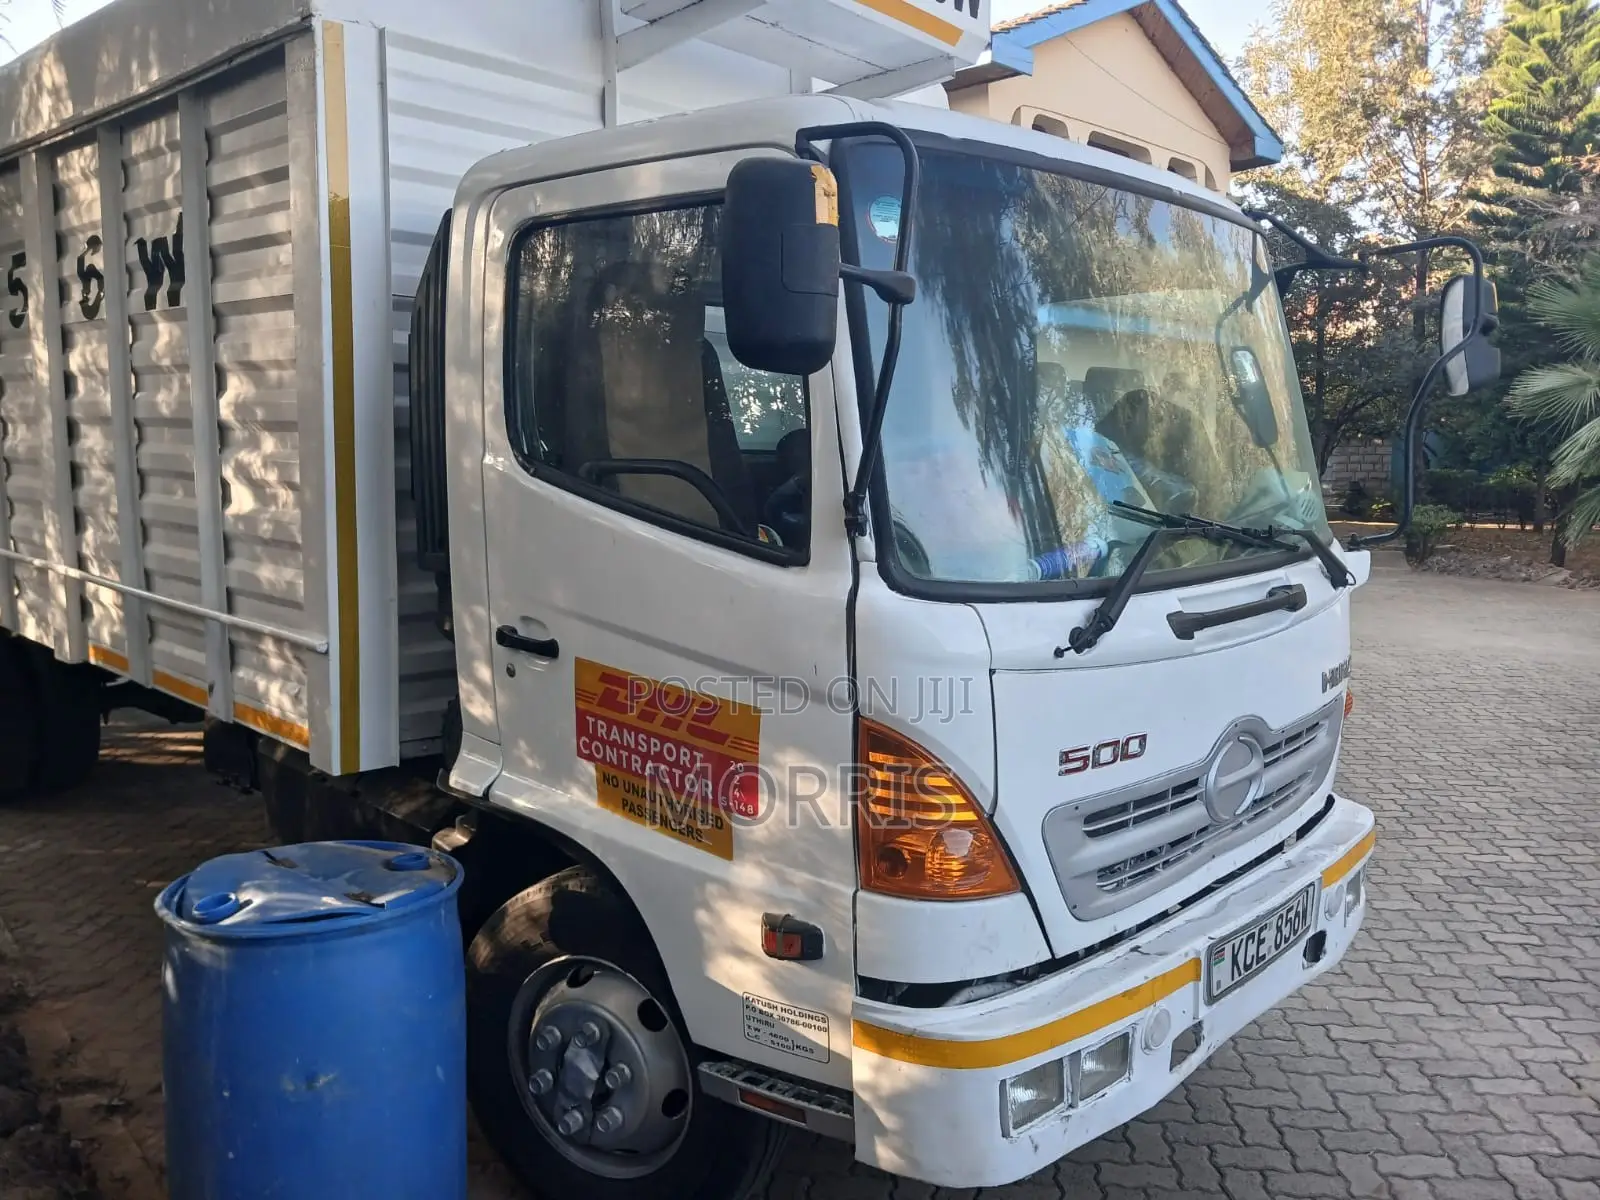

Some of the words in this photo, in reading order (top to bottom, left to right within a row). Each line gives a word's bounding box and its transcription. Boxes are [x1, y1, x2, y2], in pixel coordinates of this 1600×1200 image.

[596, 672, 730, 746] DHL
[585, 715, 704, 769] TRANSPORT
[1058, 731, 1148, 776] 500
[578, 735, 714, 800] CONTRACTOR
[729, 760, 745, 773] 20
[602, 771, 620, 789] NO
[622, 779, 724, 831] UNAUTHORISED
[621, 798, 704, 843] PASSENGERS
[1231, 923, 1268, 982] KCE
[745, 995, 778, 1012] KATUSH
[780, 1006, 827, 1025] HOLDINGS
[745, 1014, 775, 1030] UTHIRU
[758, 1008, 775, 1020] BOX
